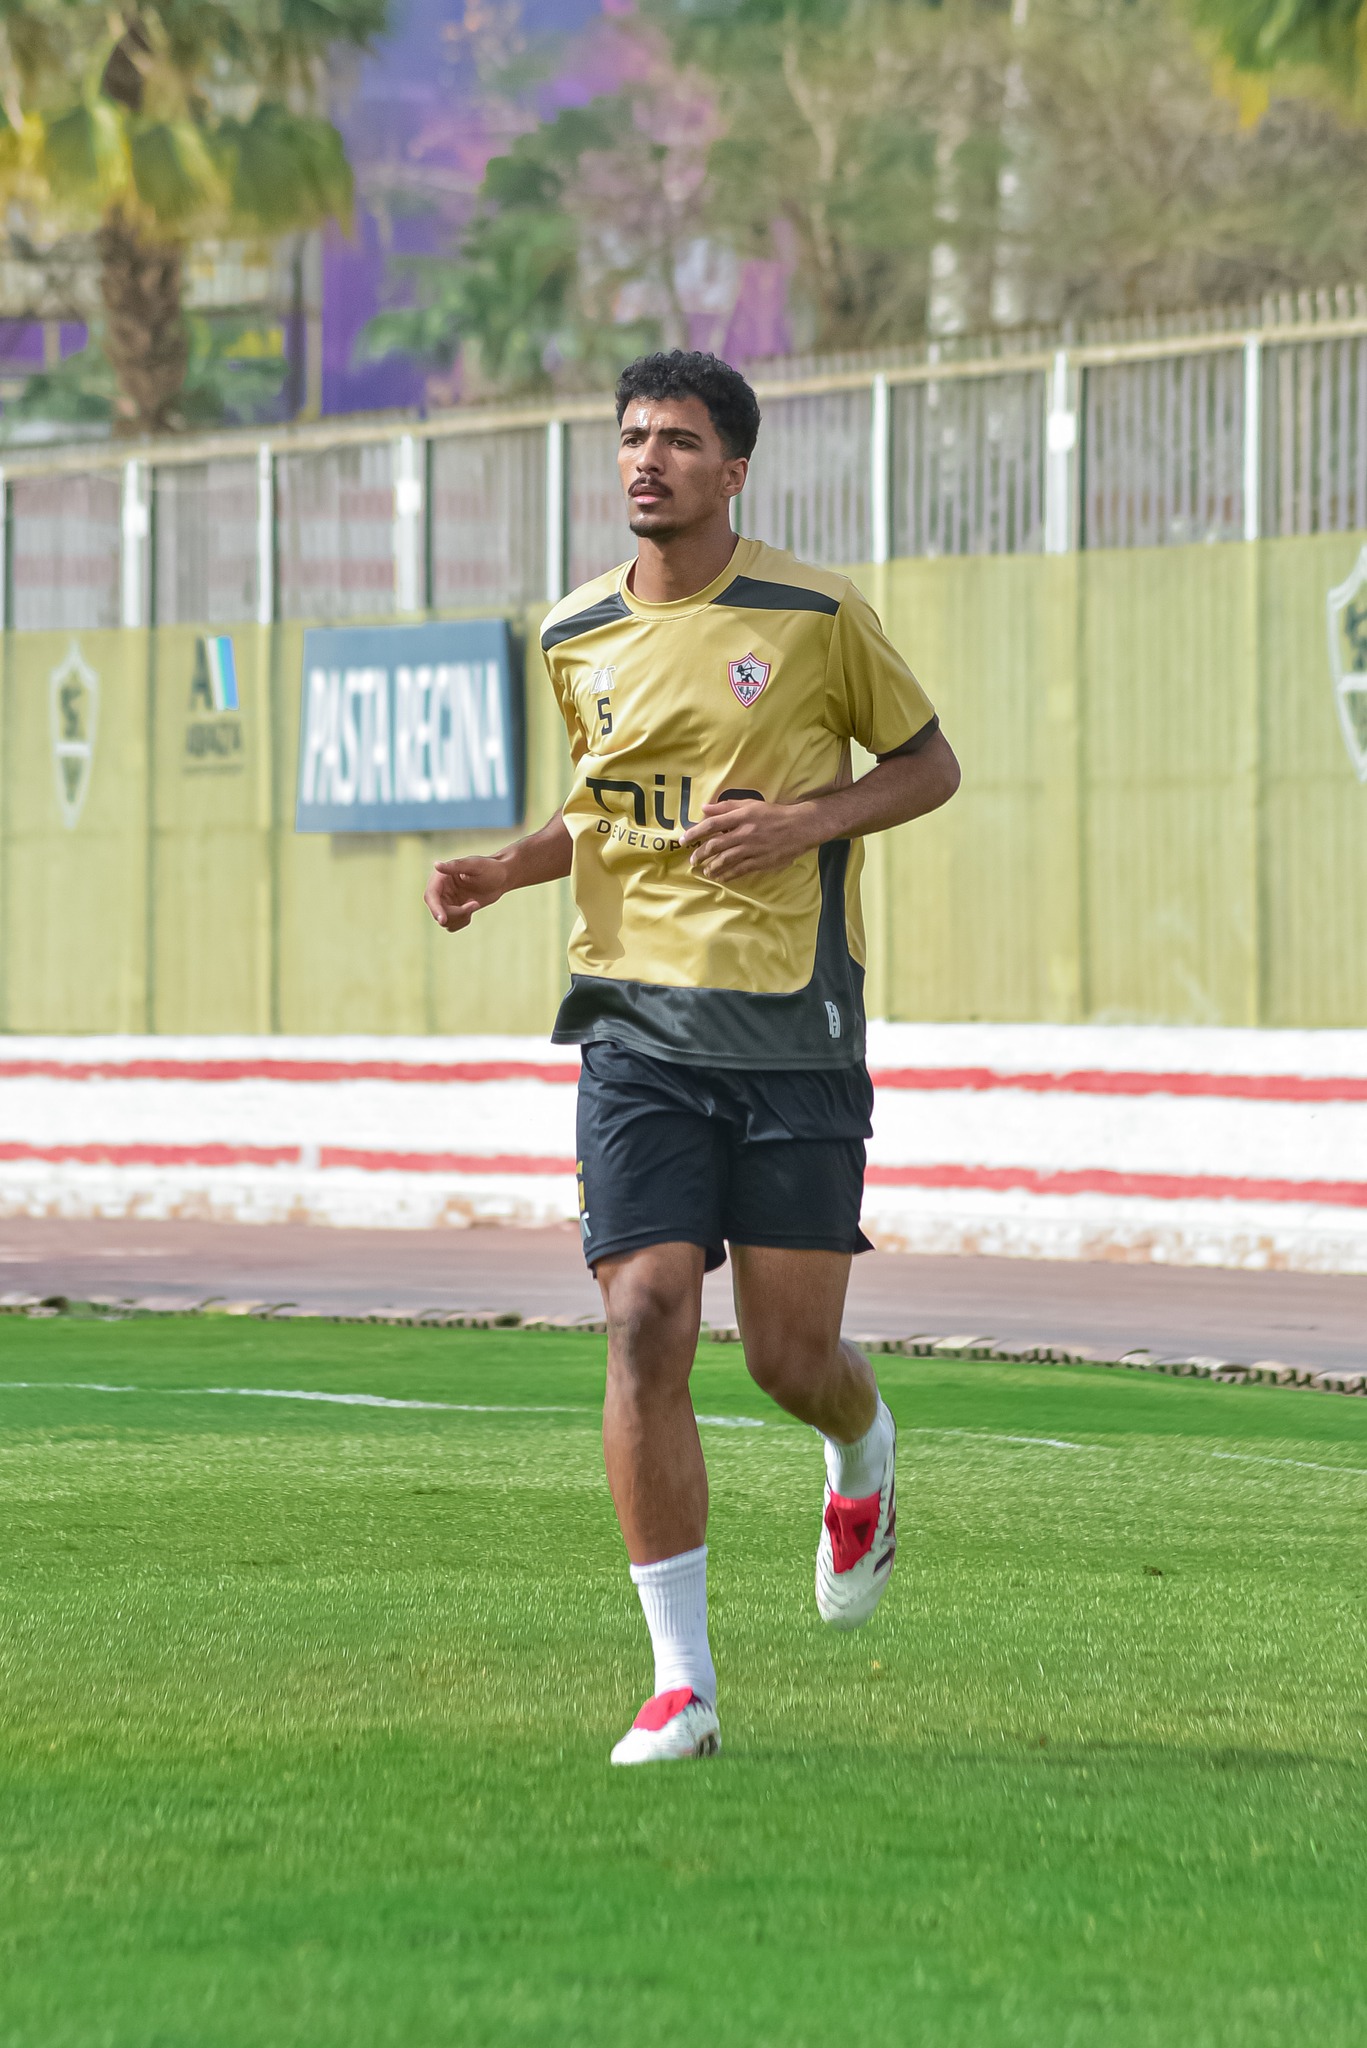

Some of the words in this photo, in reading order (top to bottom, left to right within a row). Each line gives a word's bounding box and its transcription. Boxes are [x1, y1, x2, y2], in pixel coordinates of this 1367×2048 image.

[303, 666, 390, 805] PASTA
[396, 660, 507, 803] REGINA
[597, 696, 612, 735] 5
